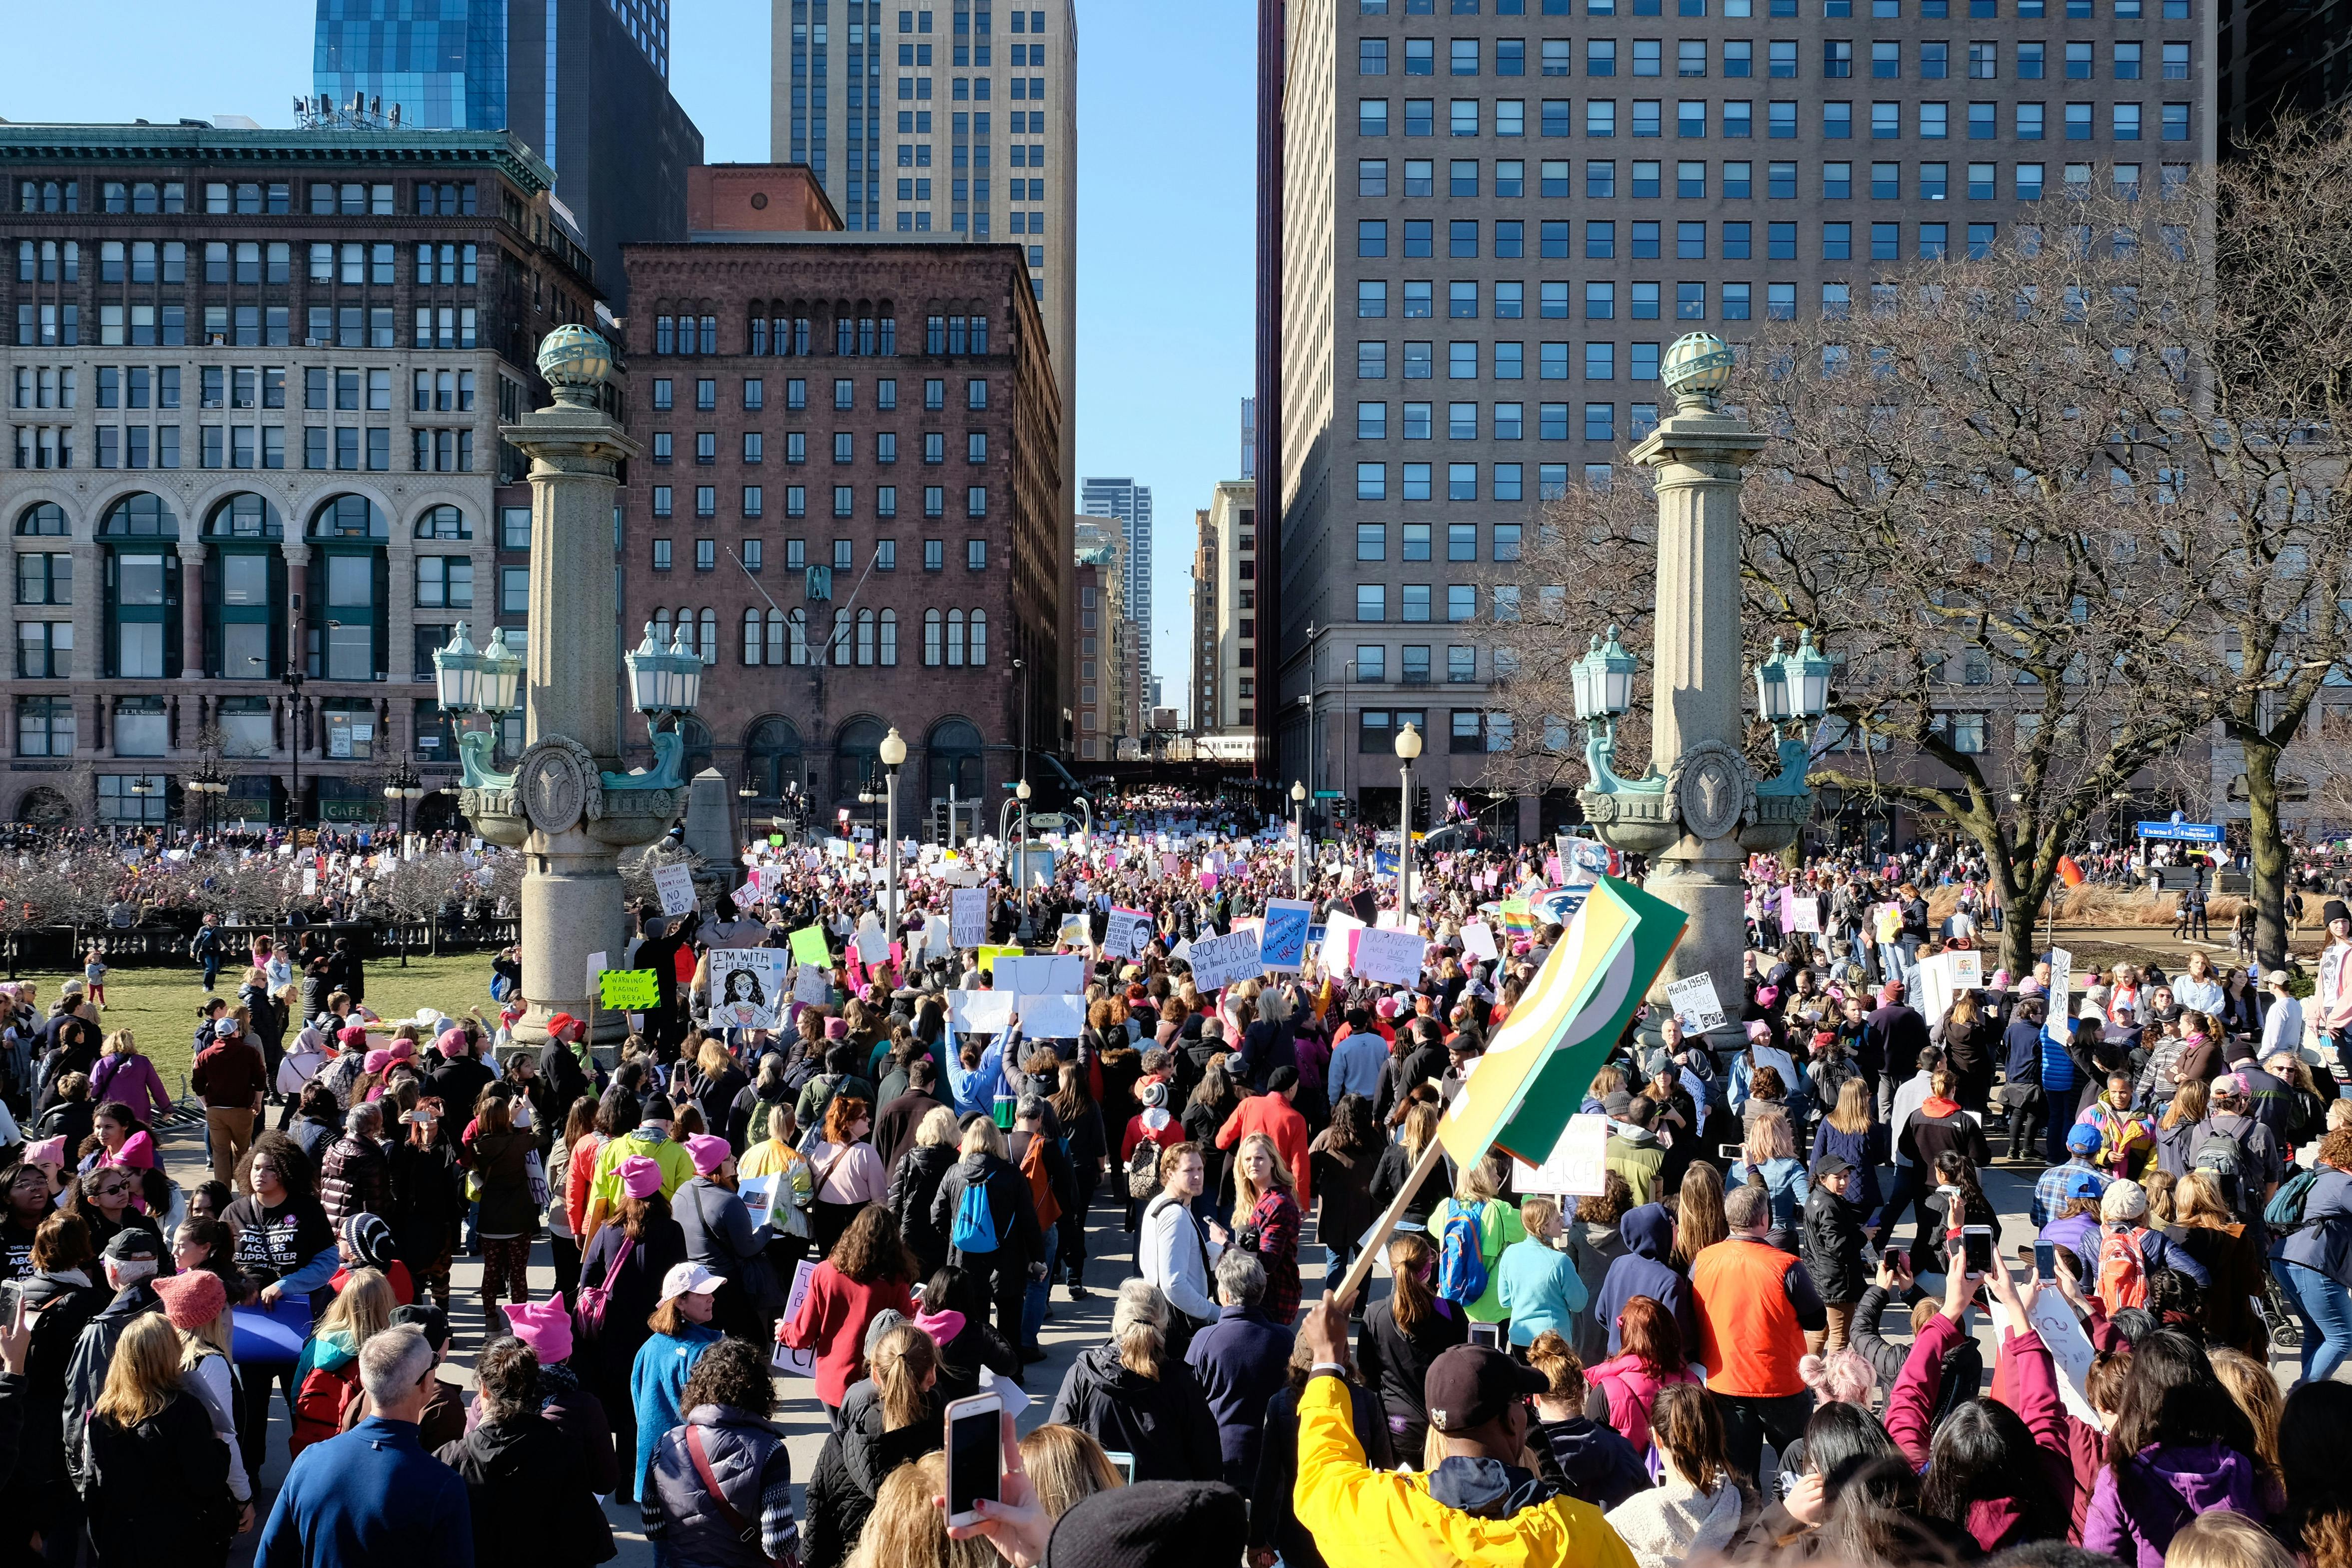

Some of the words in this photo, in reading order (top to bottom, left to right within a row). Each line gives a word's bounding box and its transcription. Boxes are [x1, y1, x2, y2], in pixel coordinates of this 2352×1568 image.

[328, 806, 363, 817] CAFE
[667, 890, 679, 903] NO
[671, 904, 684, 914] NO
[1109, 921, 1128, 929] SUCCEED
[1118, 916, 1135, 924] CANNOT
[953, 926, 968, 945] TAX
[1189, 939, 1217, 960] STOP
[1219, 931, 1256, 952] PUTIN
[1263, 933, 1290, 953] Human
[713, 950, 735, 962] I'M
[740, 951, 769, 963] WITH
[1387, 948, 1409, 957] NOT
[725, 961, 756, 971] HER
[1192, 961, 1207, 973] Your
[1209, 954, 1227, 969] Hands
[1230, 950, 1240, 963] On
[1242, 947, 1258, 960] Our
[1197, 972, 1224, 992] CIVIL
[1225, 960, 1262, 982] RIGHTS
[811, 980, 822, 989] THE
[1668, 982, 1688, 996] Hello
[1688, 973, 1710, 990] 1955?
[1694, 994, 1713, 1009] HOLD
[1701, 1011, 1724, 1026] GOP
